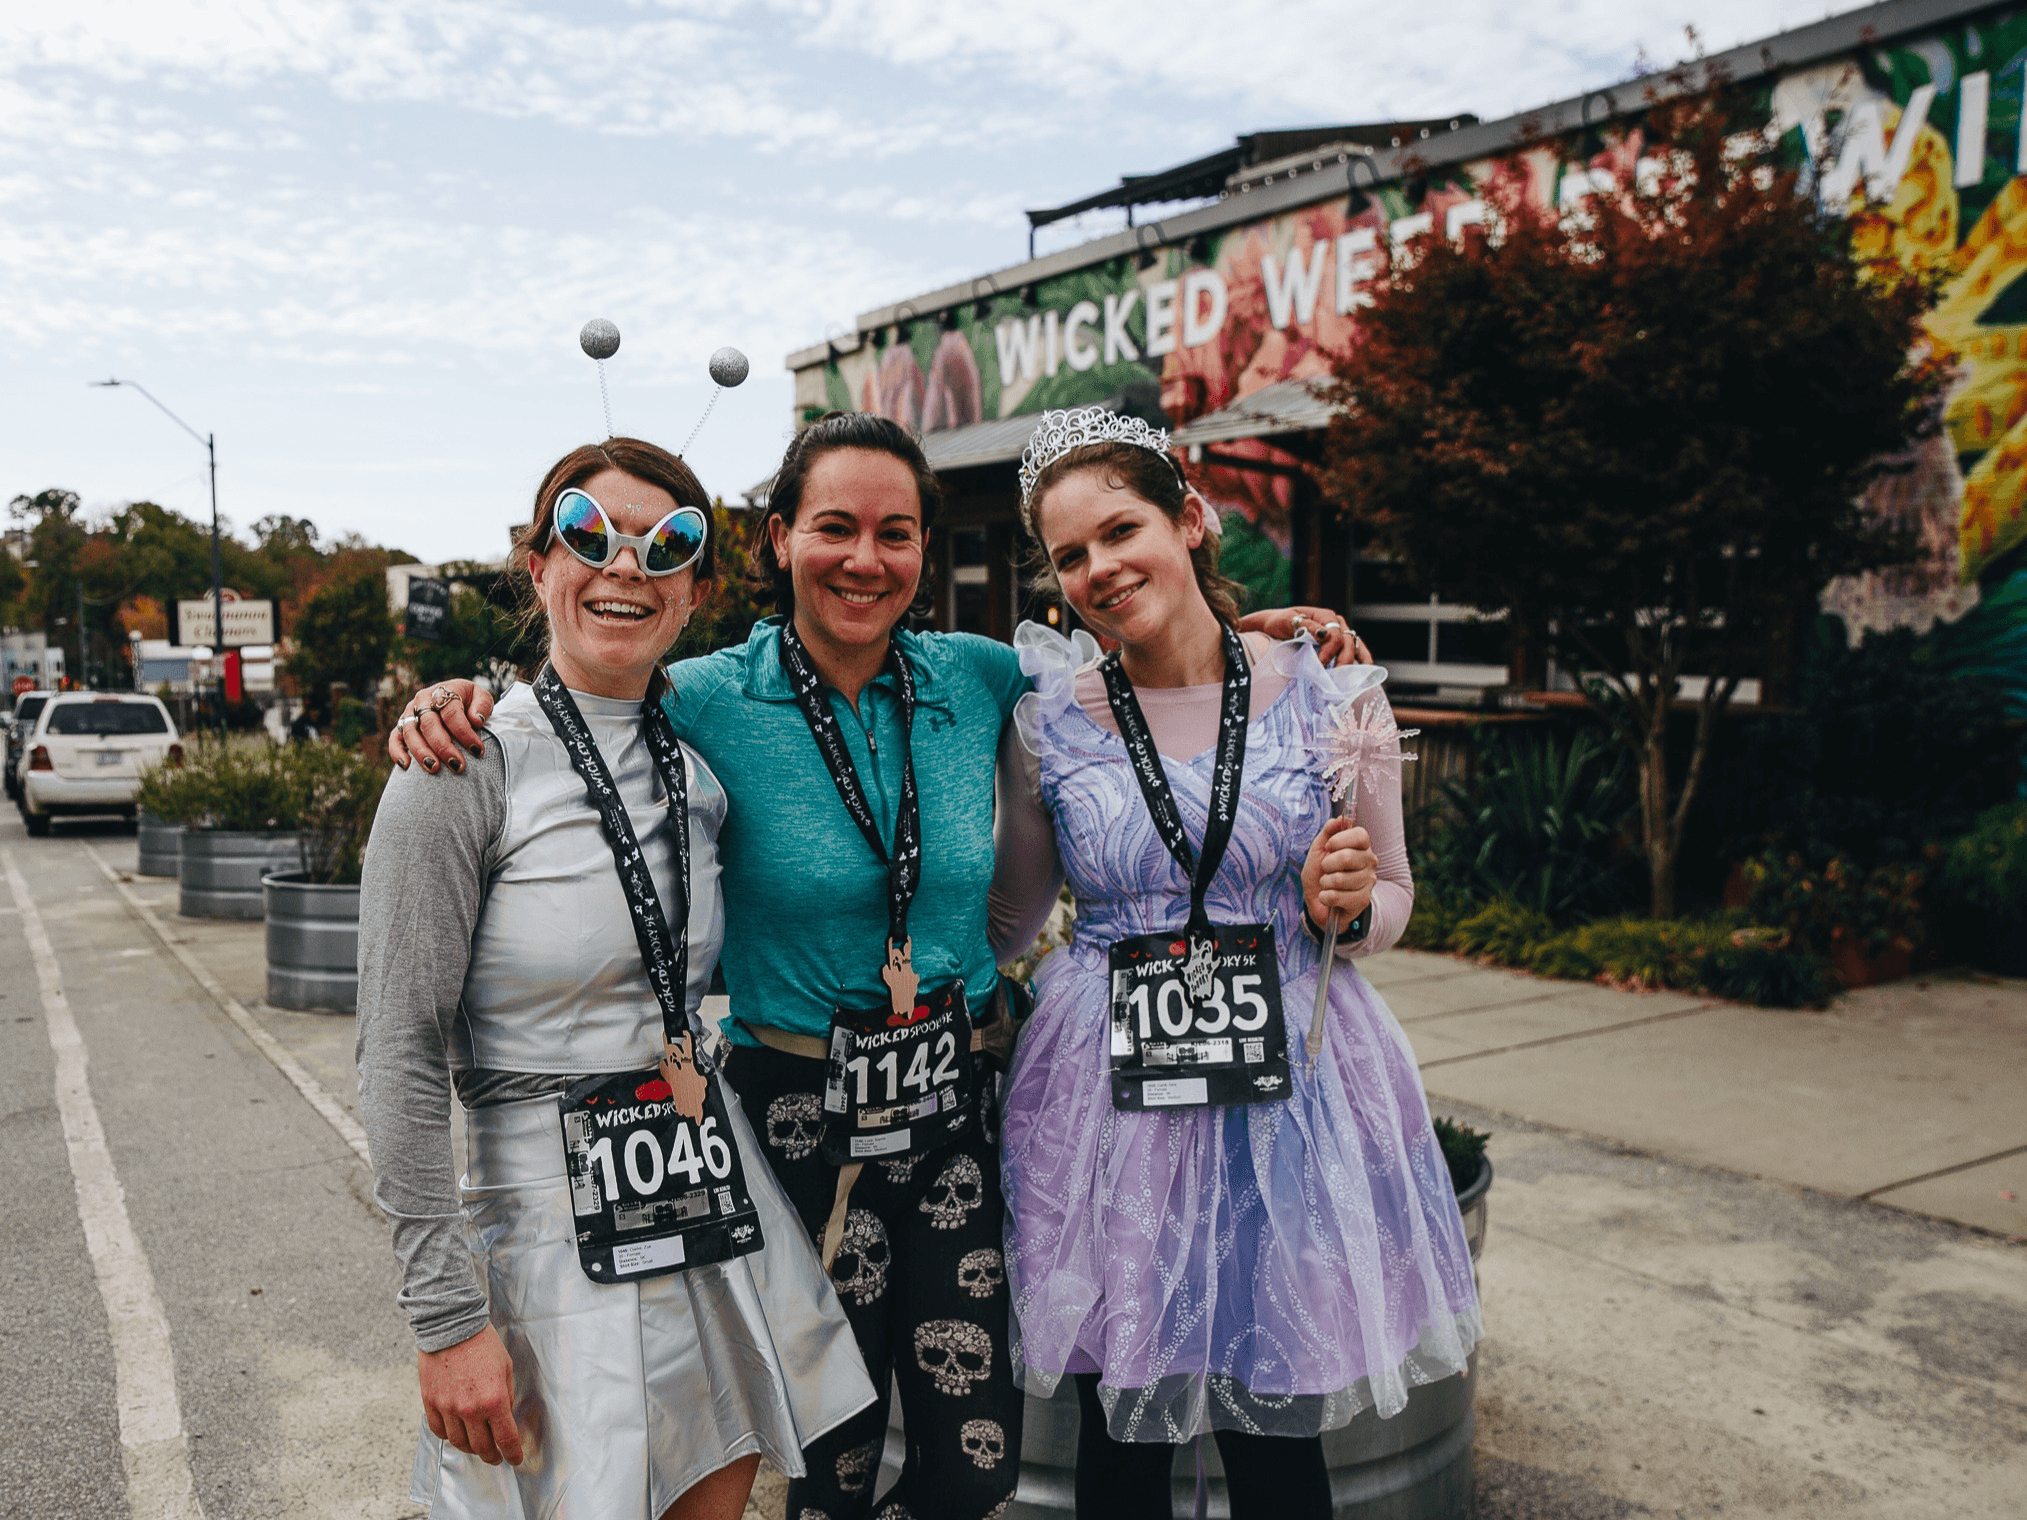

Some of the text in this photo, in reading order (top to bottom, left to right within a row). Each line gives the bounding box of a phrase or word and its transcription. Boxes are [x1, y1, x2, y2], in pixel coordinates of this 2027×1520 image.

[994, 269, 1229, 387] WICKED
[577, 741, 604, 788] WICKED
[1135, 743, 1157, 783] WICKED
[1218, 768, 1231, 814] WICKED
[1128, 974, 1268, 1039] 1035
[855, 1028, 910, 1050] WICKED
[846, 1031, 959, 1105] 1142
[595, 1104, 661, 1128] WICKED
[590, 1116, 732, 1201] 1046
